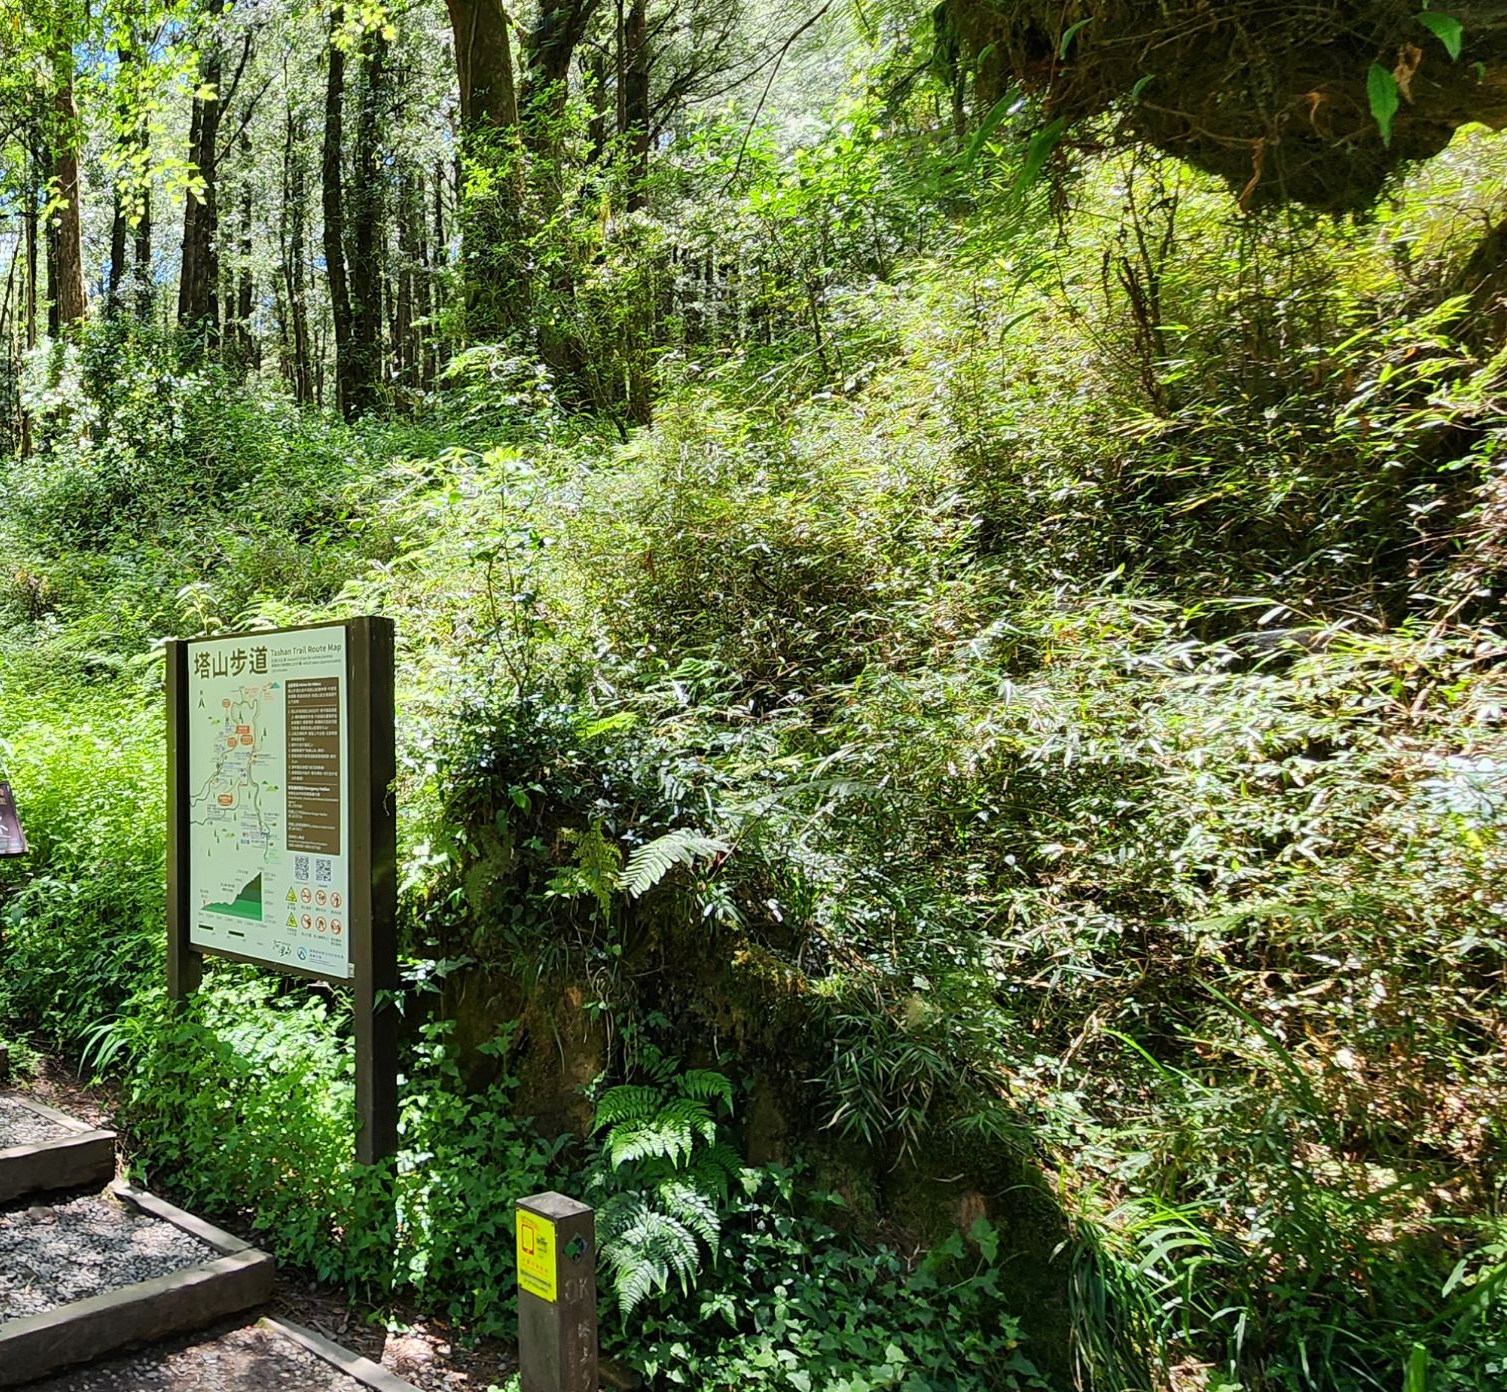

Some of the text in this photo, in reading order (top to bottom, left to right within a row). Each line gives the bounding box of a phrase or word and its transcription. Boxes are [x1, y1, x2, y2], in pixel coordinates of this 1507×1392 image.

[271, 643, 342, 656] Tashan Trail Route Map
[194, 646, 269, 679] 塔山步道
